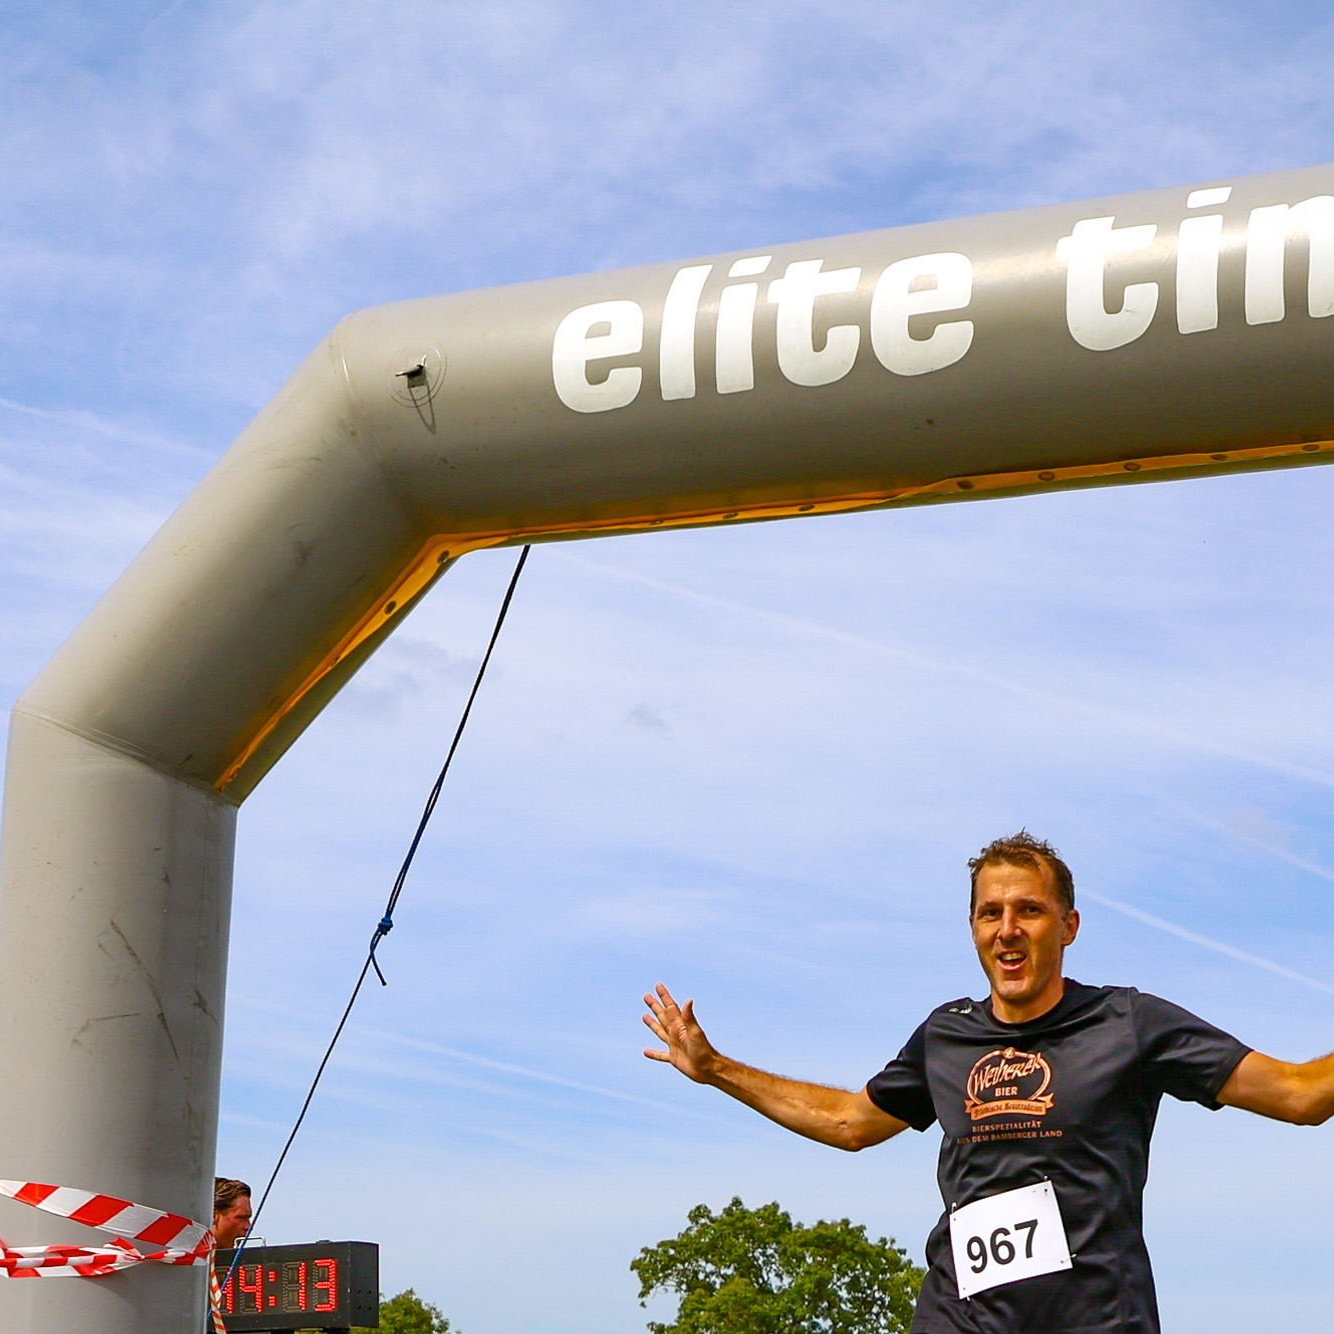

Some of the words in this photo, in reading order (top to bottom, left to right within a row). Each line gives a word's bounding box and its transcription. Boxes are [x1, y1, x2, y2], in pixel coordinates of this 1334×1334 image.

[552, 254, 974, 414] elite
[994, 1086, 1018, 1097] BIER
[972, 1121, 1042, 1132] BIERSPEZIALITÄT
[957, 1137, 970, 1145] AUS
[972, 1134, 989, 1143] DEM
[991, 1131, 1037, 1140] BAMBERGER
[1039, 1130, 1063, 1138] LAND
[966, 1218, 1039, 1274] 967
